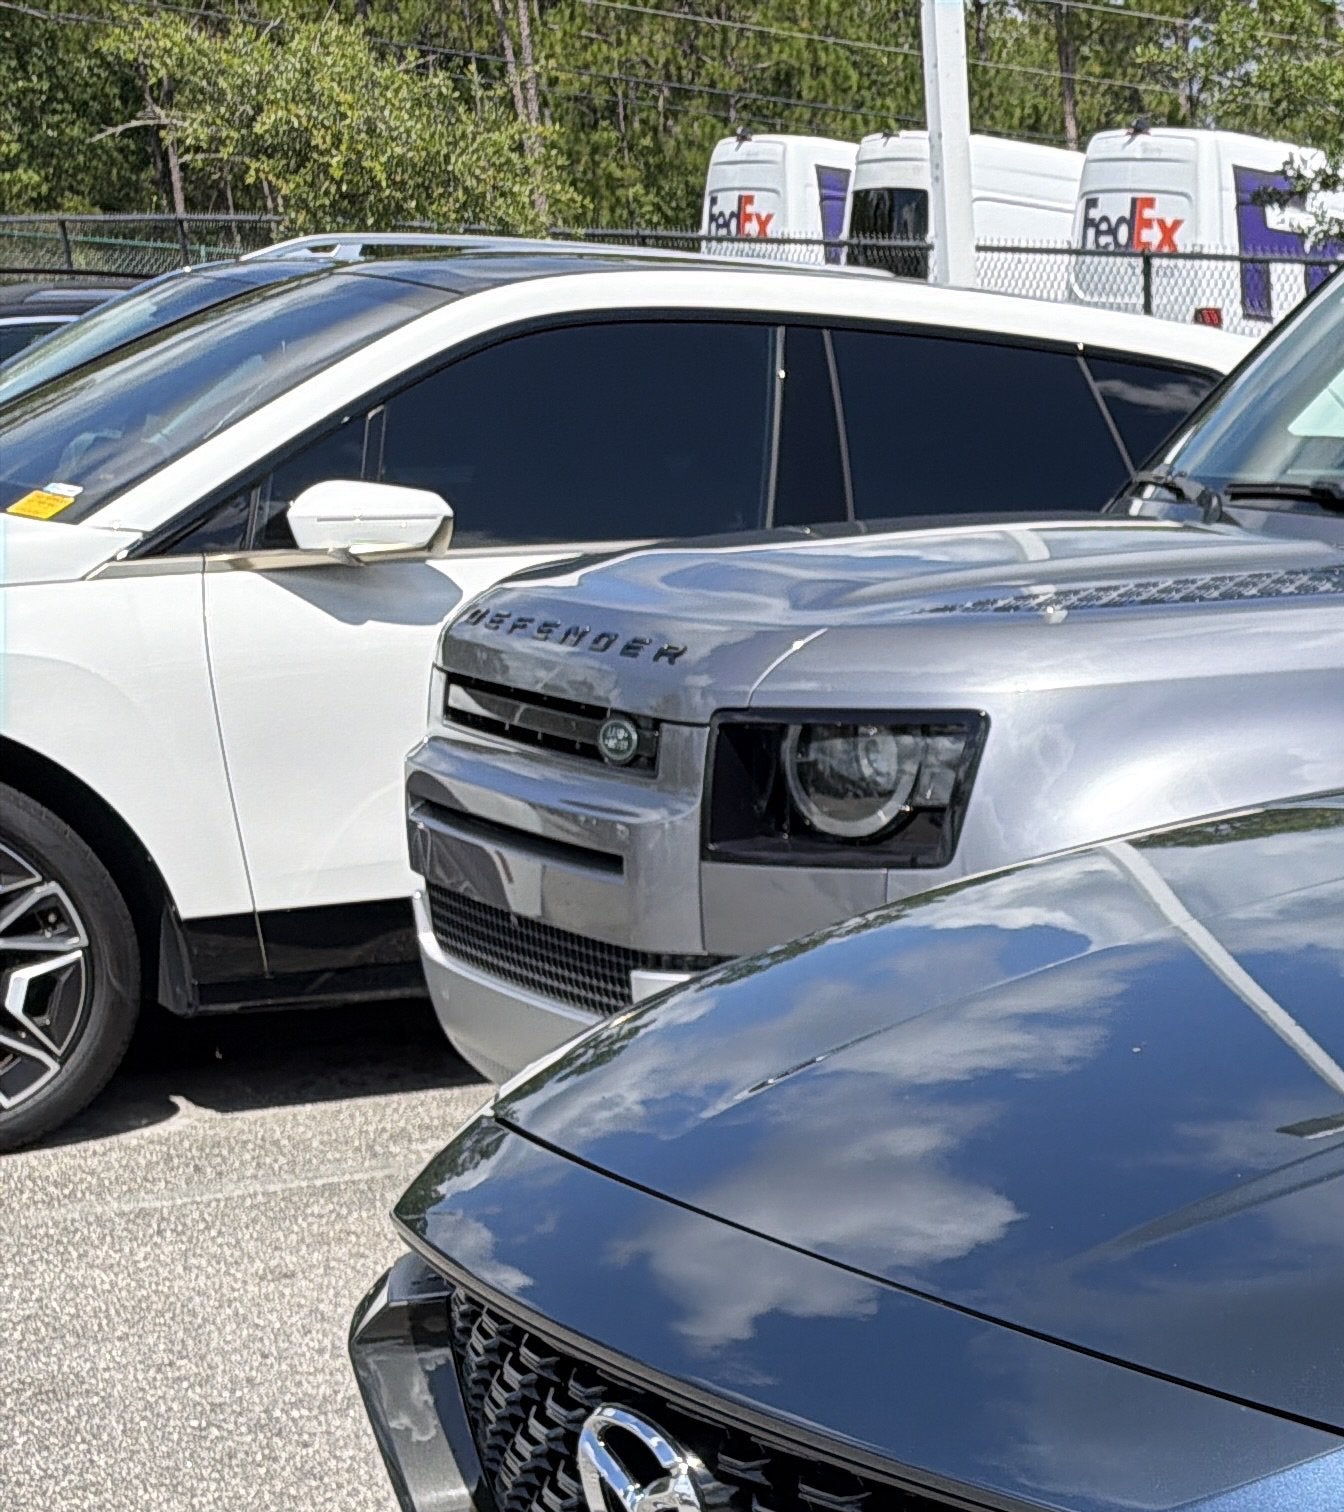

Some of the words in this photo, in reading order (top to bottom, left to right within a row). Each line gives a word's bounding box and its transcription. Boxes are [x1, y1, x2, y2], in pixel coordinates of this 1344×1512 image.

[708, 194, 775, 237] FedEx
[1082, 196, 1185, 253] FedEx
[464, 607, 688, 666] DEFENDER
